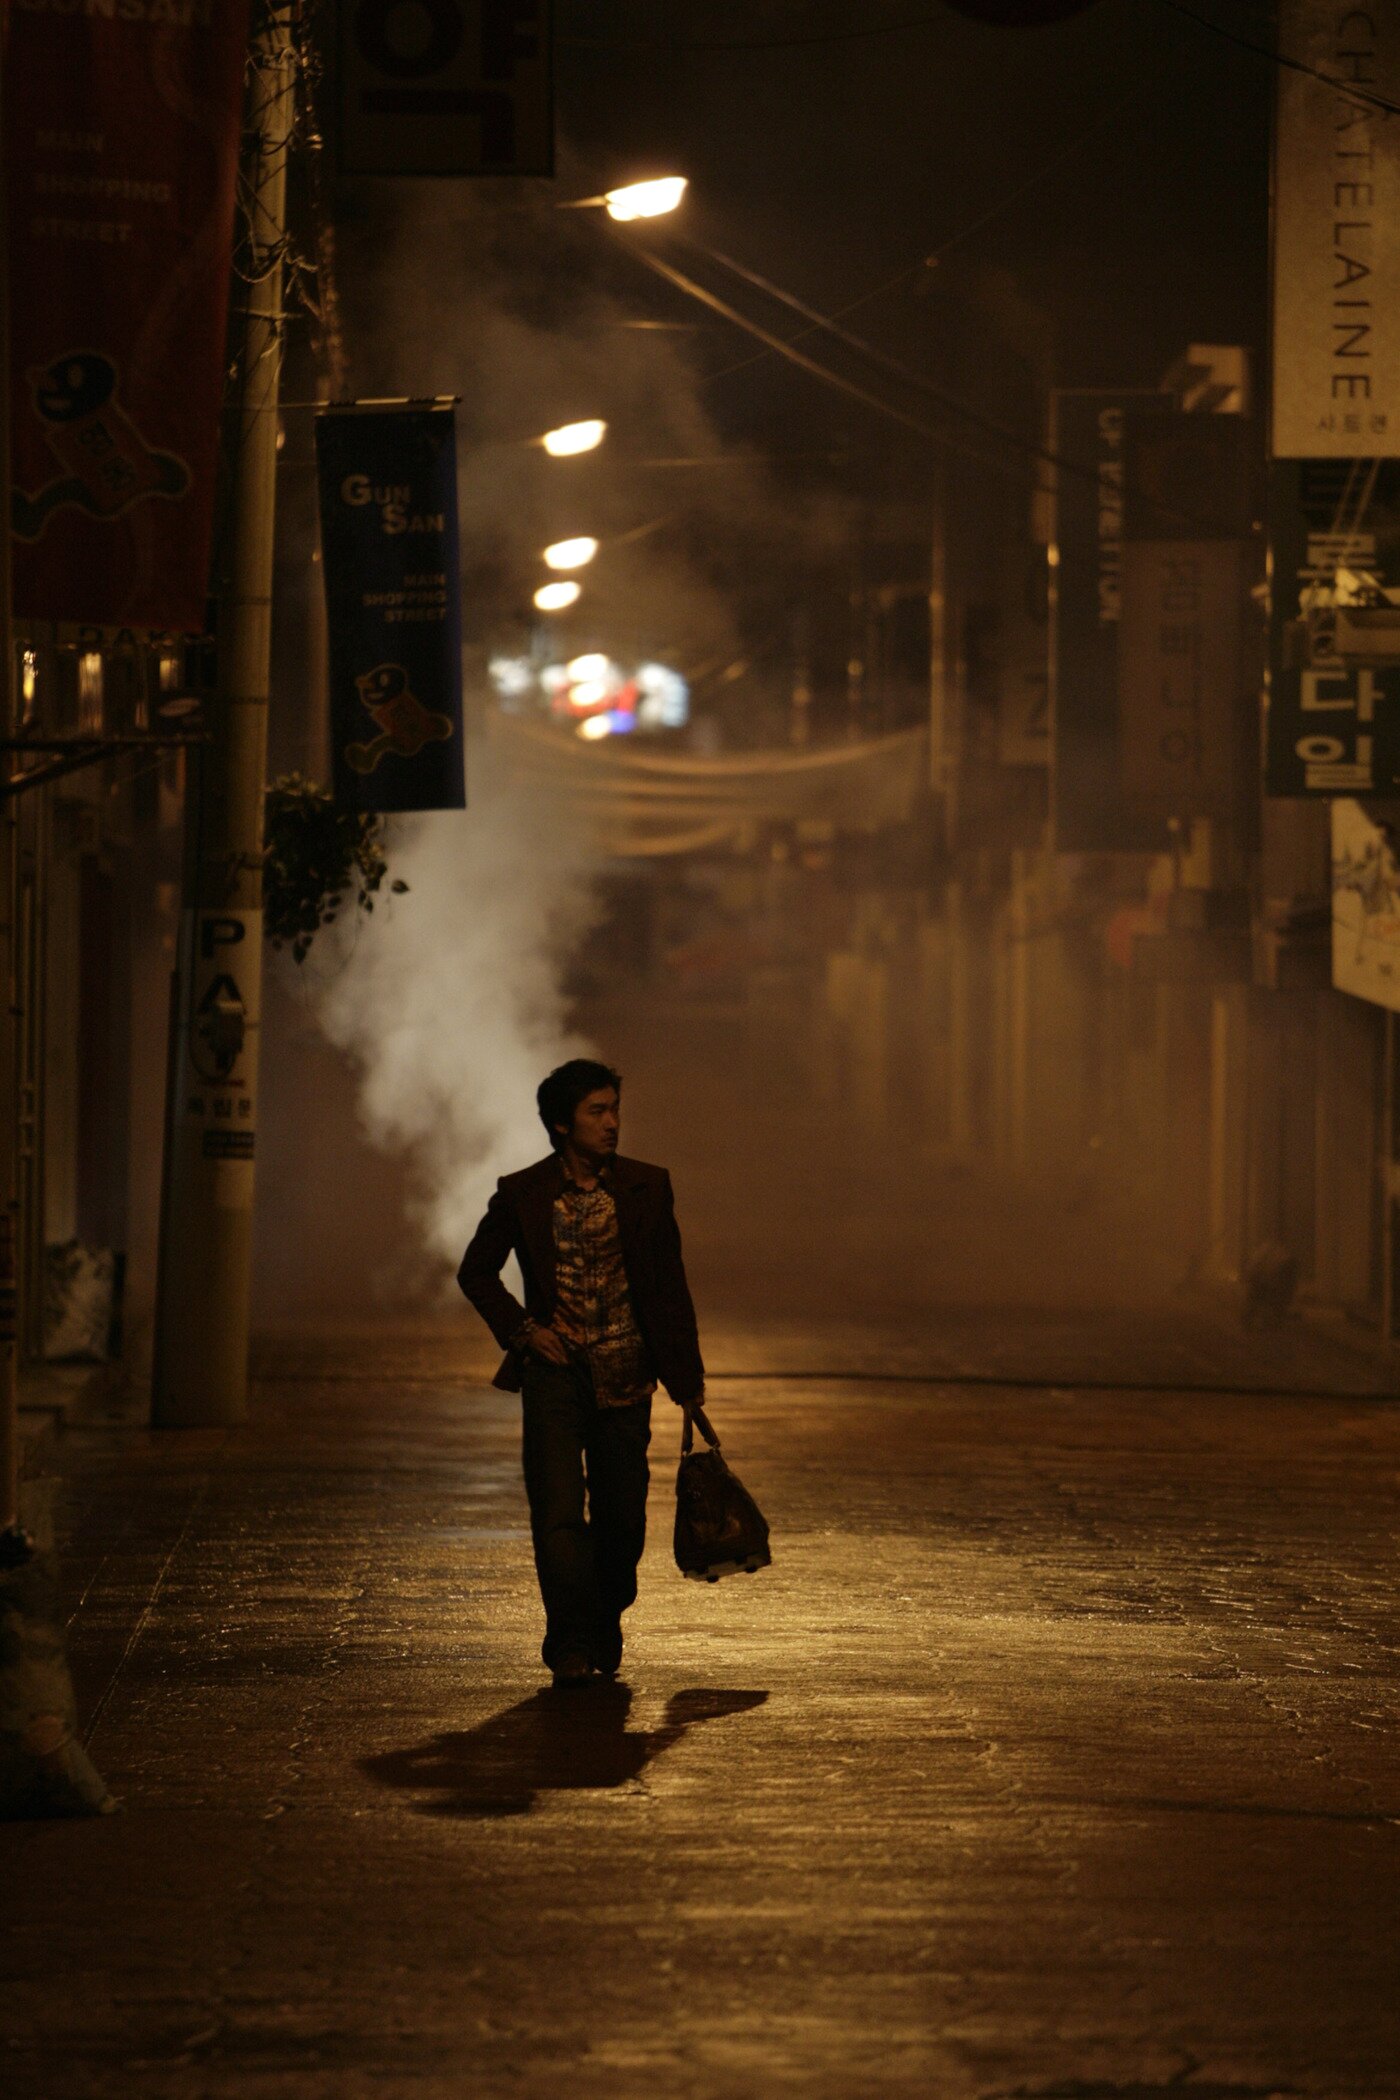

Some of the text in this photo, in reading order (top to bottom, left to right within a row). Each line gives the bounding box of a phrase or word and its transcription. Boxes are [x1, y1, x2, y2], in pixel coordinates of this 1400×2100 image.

[1331, 10, 1376, 398] CHATELAINE
[403, 573, 447, 587] MAIN
[362, 589, 448, 607] SHOPPING
[384, 607, 448, 623] STREET
